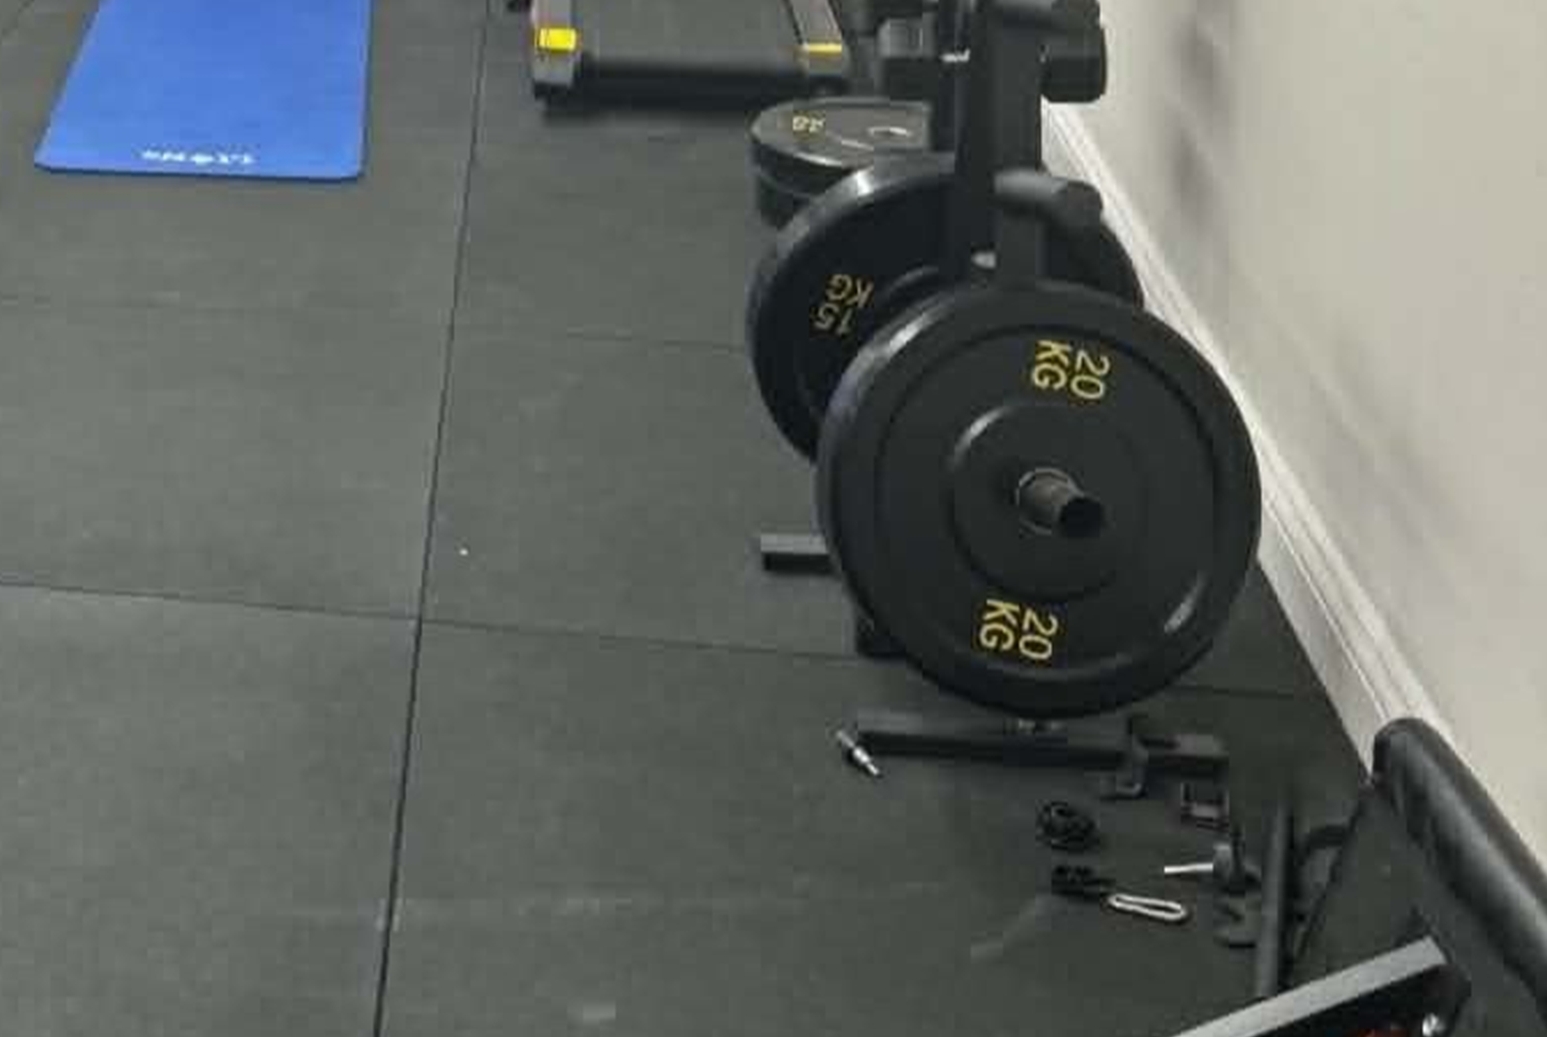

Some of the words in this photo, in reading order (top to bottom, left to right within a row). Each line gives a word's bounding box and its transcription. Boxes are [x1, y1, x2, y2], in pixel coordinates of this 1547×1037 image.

[826, 274, 874, 308] KG
[814, 304, 852, 336] 15
[1032, 340, 1071, 391] KG
[1072, 349, 1110, 400] 20
[980, 599, 1019, 651] KG
[1020, 613, 1058, 661] 20
